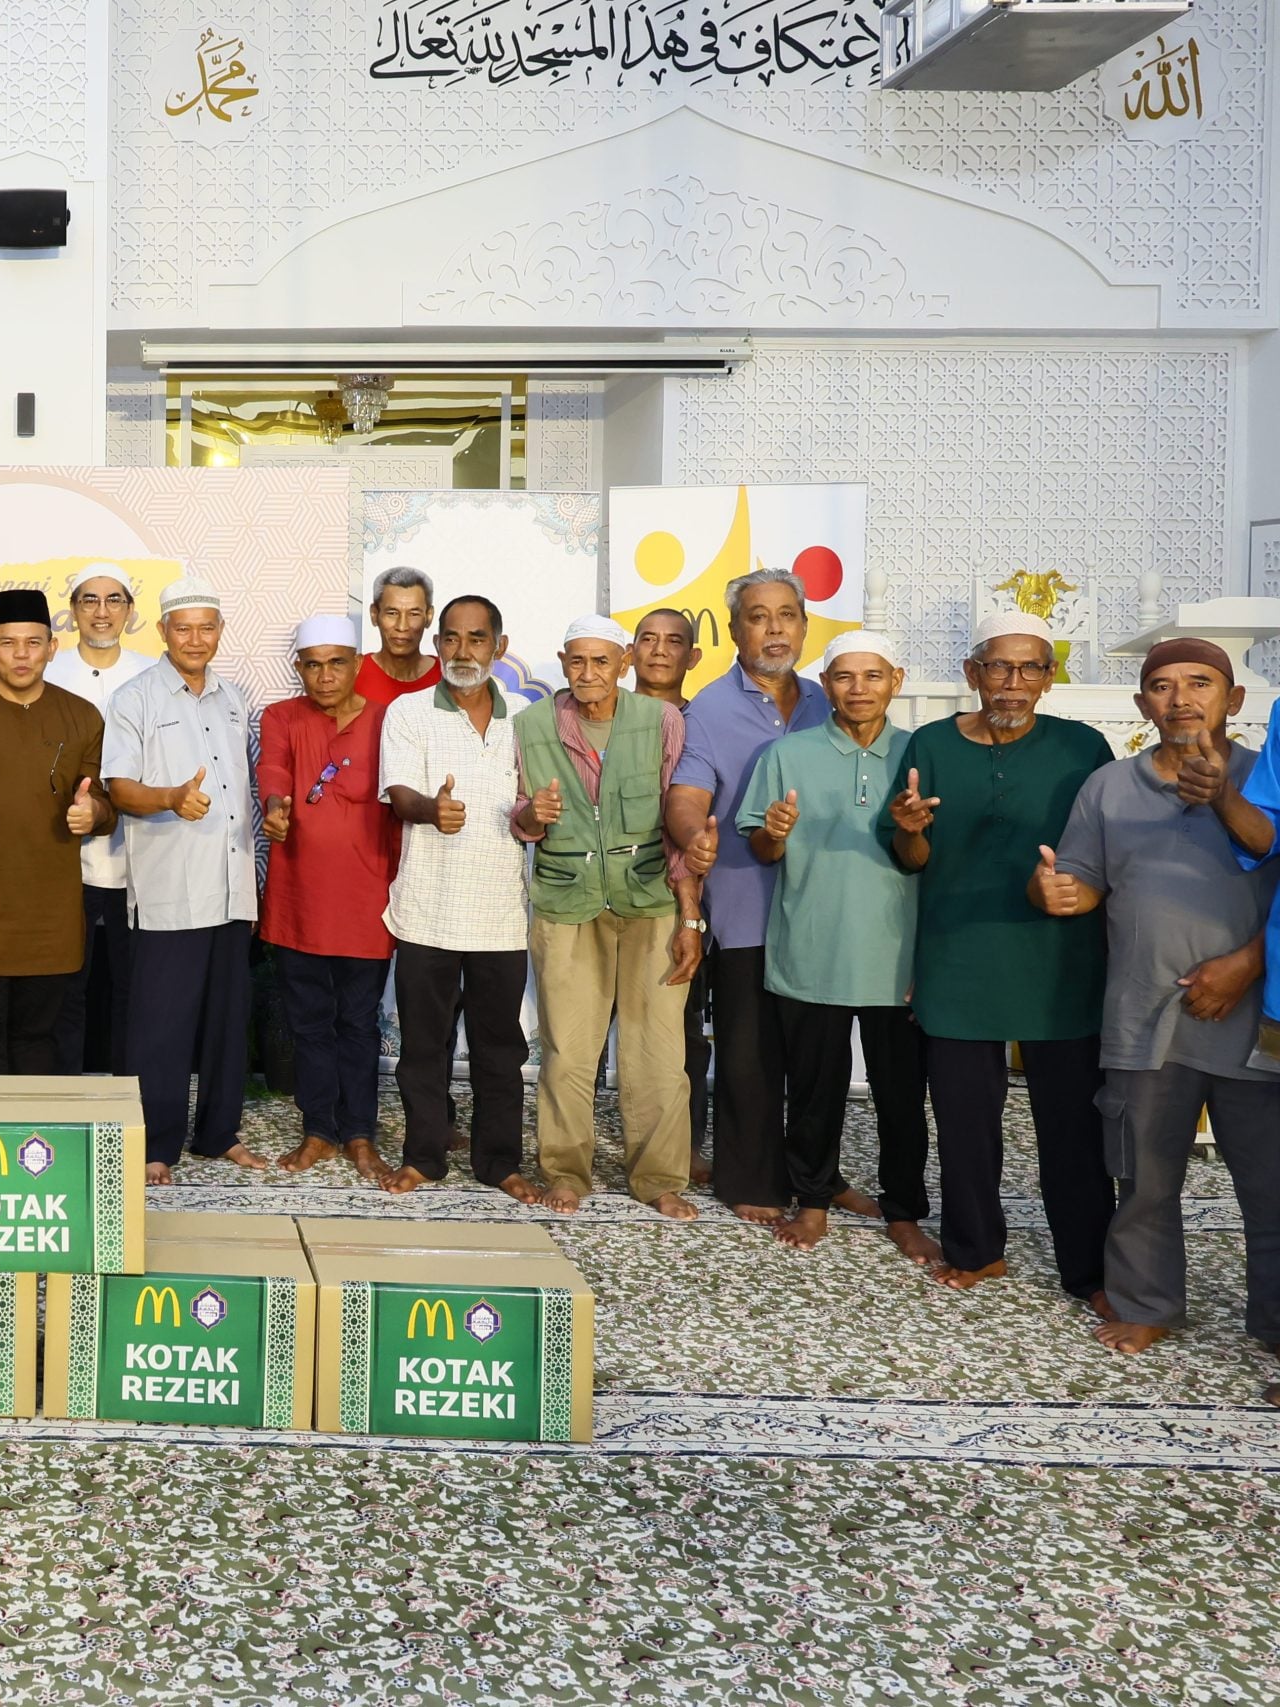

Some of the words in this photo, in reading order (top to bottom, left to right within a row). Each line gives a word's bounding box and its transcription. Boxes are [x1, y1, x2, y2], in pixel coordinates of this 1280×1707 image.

[1124, 36, 1203, 120] الله
[126, 1344, 239, 1373] KOTAK
[399, 1357, 514, 1387] KOTAK
[122, 1375, 240, 1405] REZEKI
[395, 1389, 516, 1419] REZEKI
